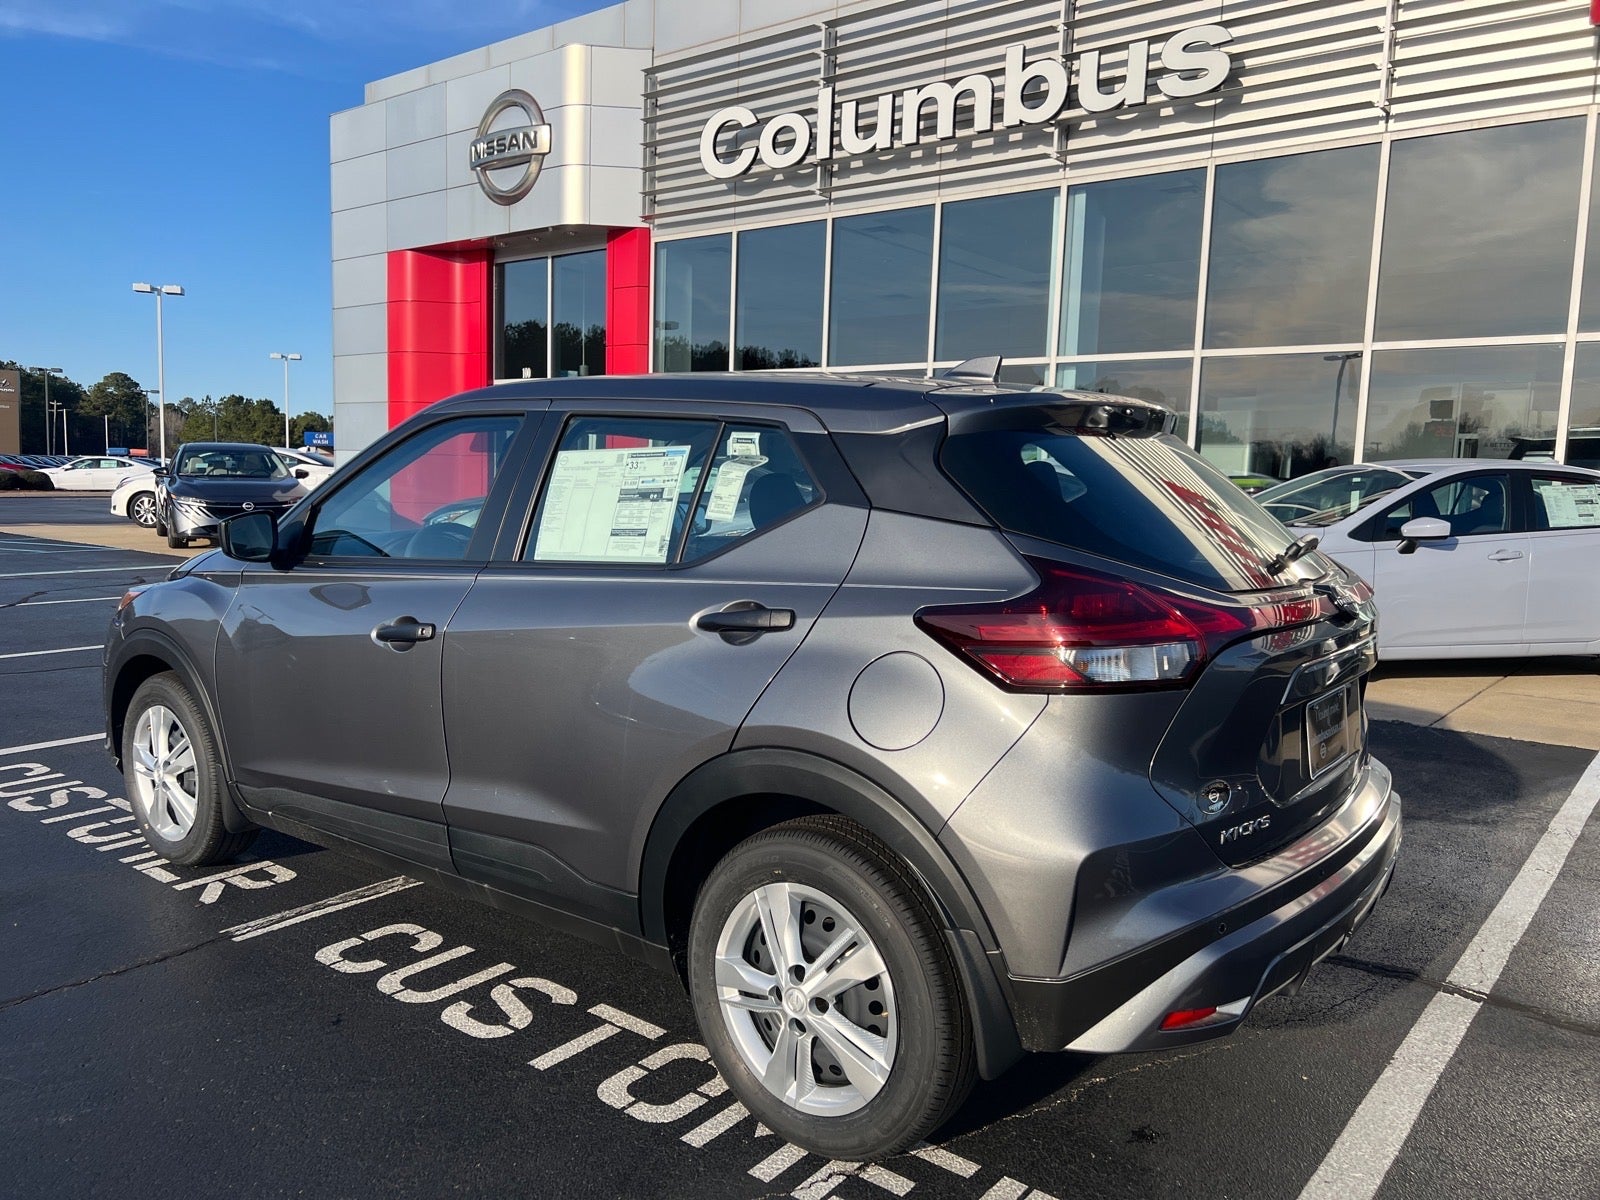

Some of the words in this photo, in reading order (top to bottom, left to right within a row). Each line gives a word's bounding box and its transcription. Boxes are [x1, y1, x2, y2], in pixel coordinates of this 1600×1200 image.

[700, 24, 1235, 178] Columbus
[471, 130, 538, 163] NISSAN
[1220, 814, 1270, 845] KICKS
